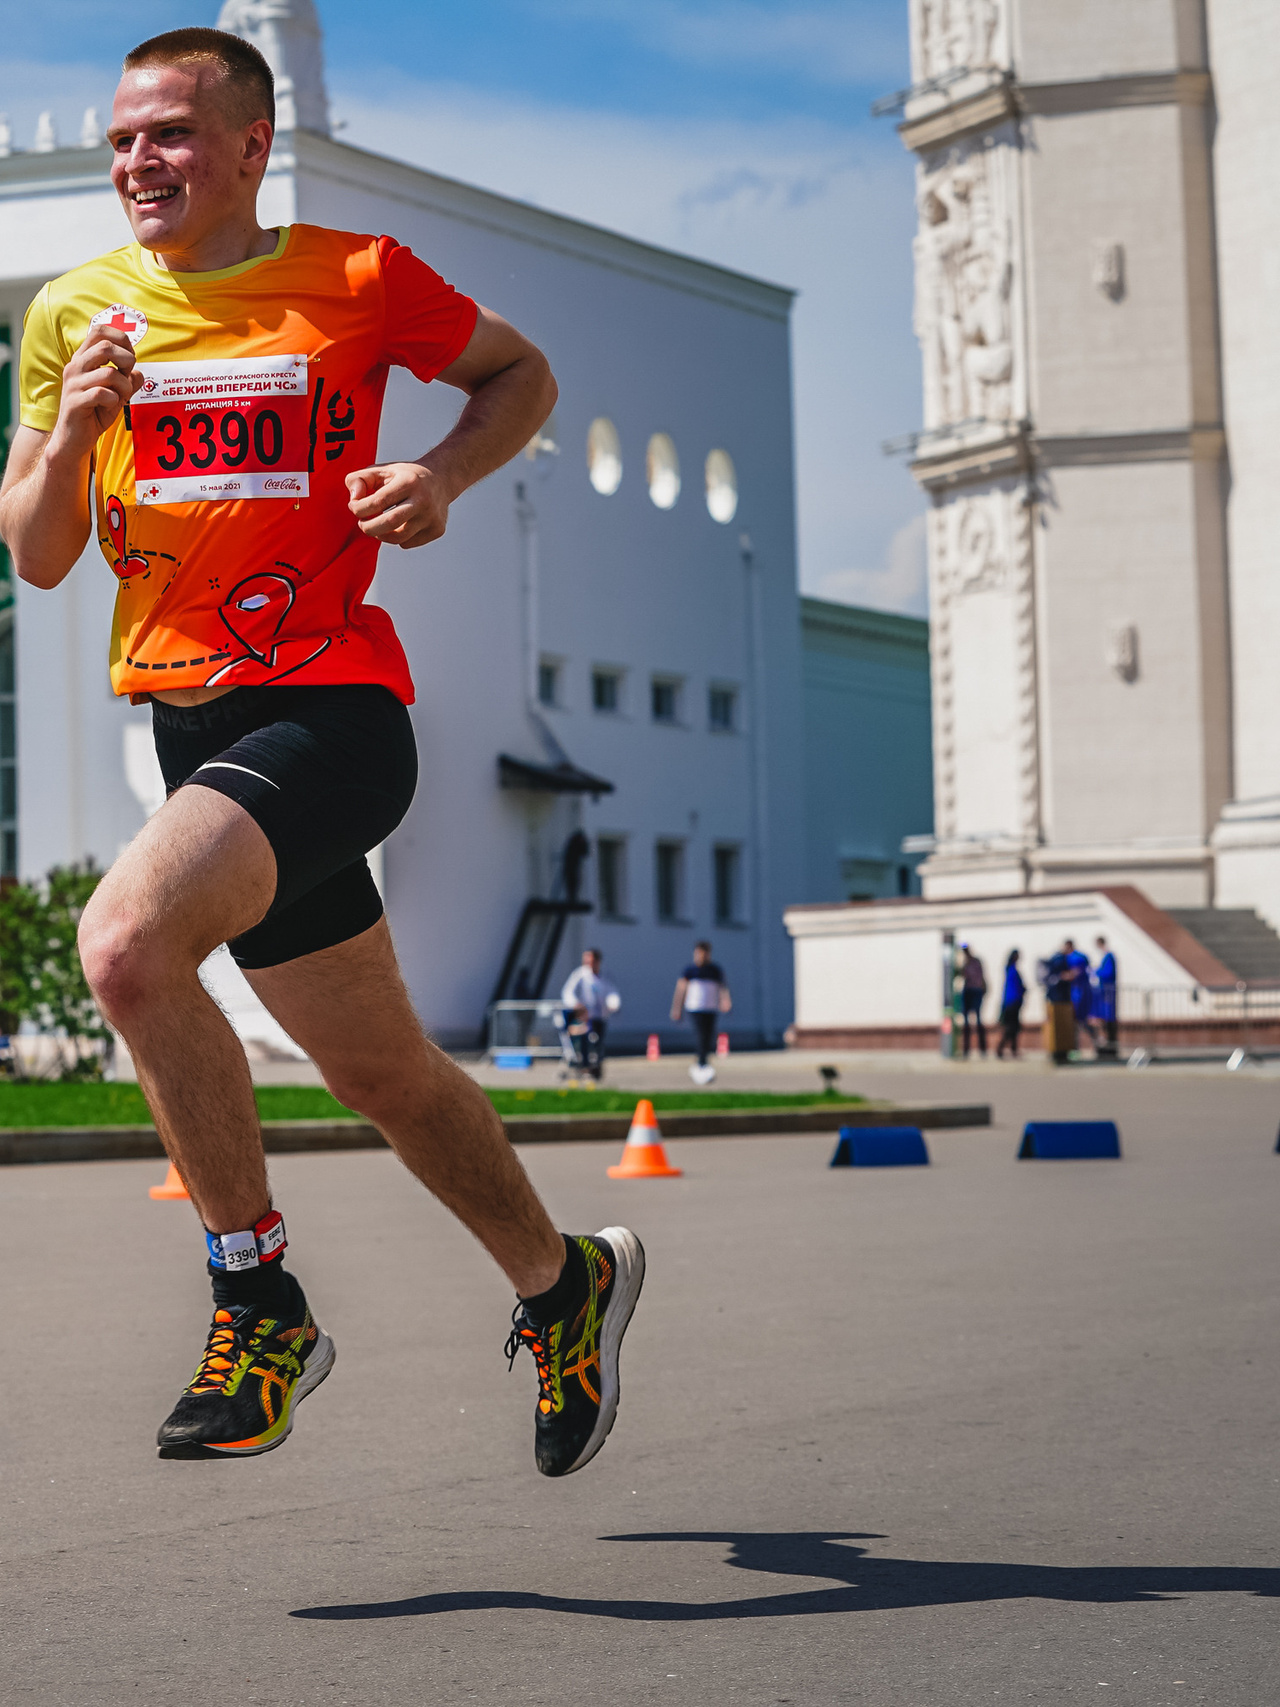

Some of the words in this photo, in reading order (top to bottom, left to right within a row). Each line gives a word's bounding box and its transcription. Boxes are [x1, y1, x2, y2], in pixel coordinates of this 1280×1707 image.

[184, 375, 233, 383] РОССИЙСКОГО
[161, 385, 214, 397] «БЕЖИМ
[216, 381, 272, 393] ВПЕРЕДИ
[274, 381, 298, 391] ЧС»
[184, 400, 233, 411] ДИСТАНЦИЯ
[234, 399, 239, 407] 5
[156, 409, 283, 472] 3390
[223, 482, 241, 490] 2021
[228, 1247, 256, 1264] 3390
